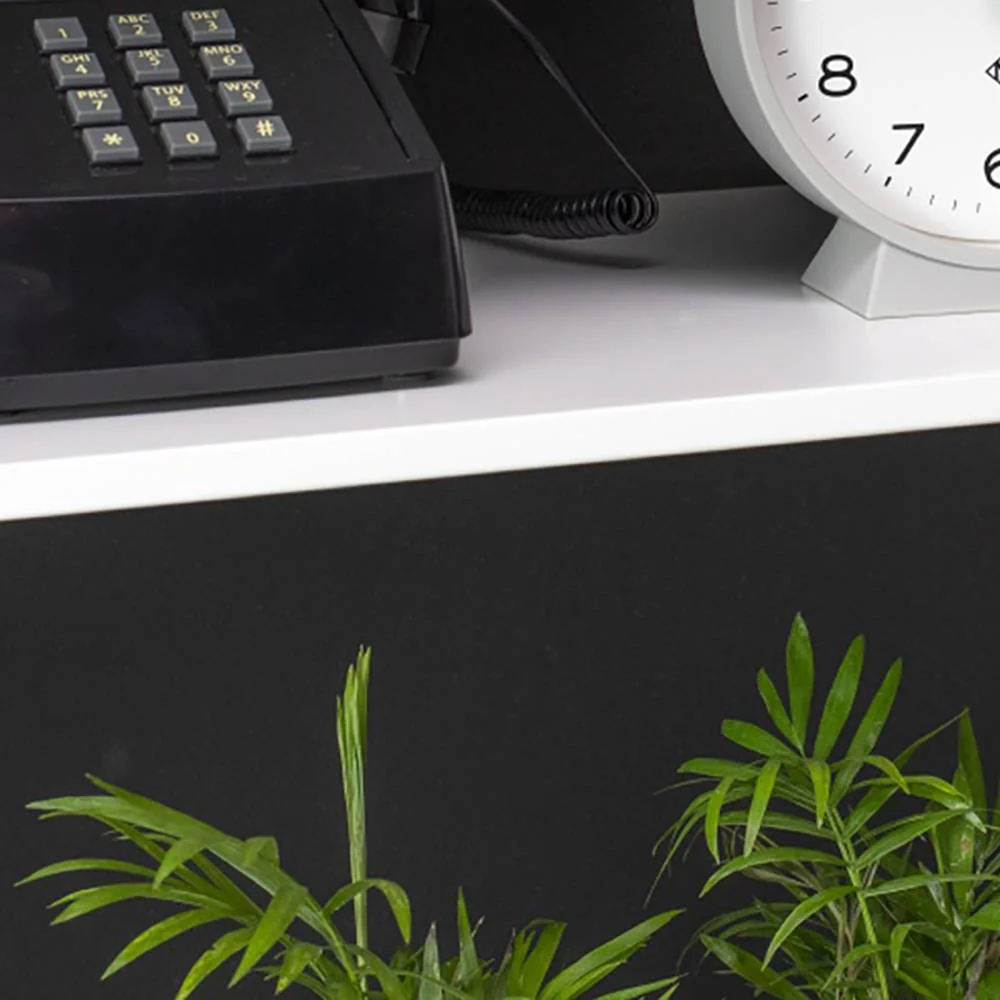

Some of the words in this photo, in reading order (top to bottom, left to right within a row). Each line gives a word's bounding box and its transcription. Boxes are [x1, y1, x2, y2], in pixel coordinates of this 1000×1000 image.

[118, 14, 149, 24] ABC
[190, 11, 221, 20] DEF
[132, 25, 144, 36] 2
[207, 20, 218, 32] 3
[58, 28, 68, 39] 1
[204, 44, 243, 55] MNO
[61, 53, 91, 63] GHI
[149, 56, 160, 67] 5
[223, 55, 236, 66] 6
[75, 63, 88, 75] 4
[818, 54, 857, 97] 8
[152, 85, 185, 95] TUV
[224, 80, 261, 92] WXY
[77, 89, 109, 99] PRS
[243, 91, 256, 103] 9
[93, 100, 104, 111] 7
[168, 96, 181, 107] 8
[186, 132, 200, 144] 0
[892, 123, 925, 165] 7
